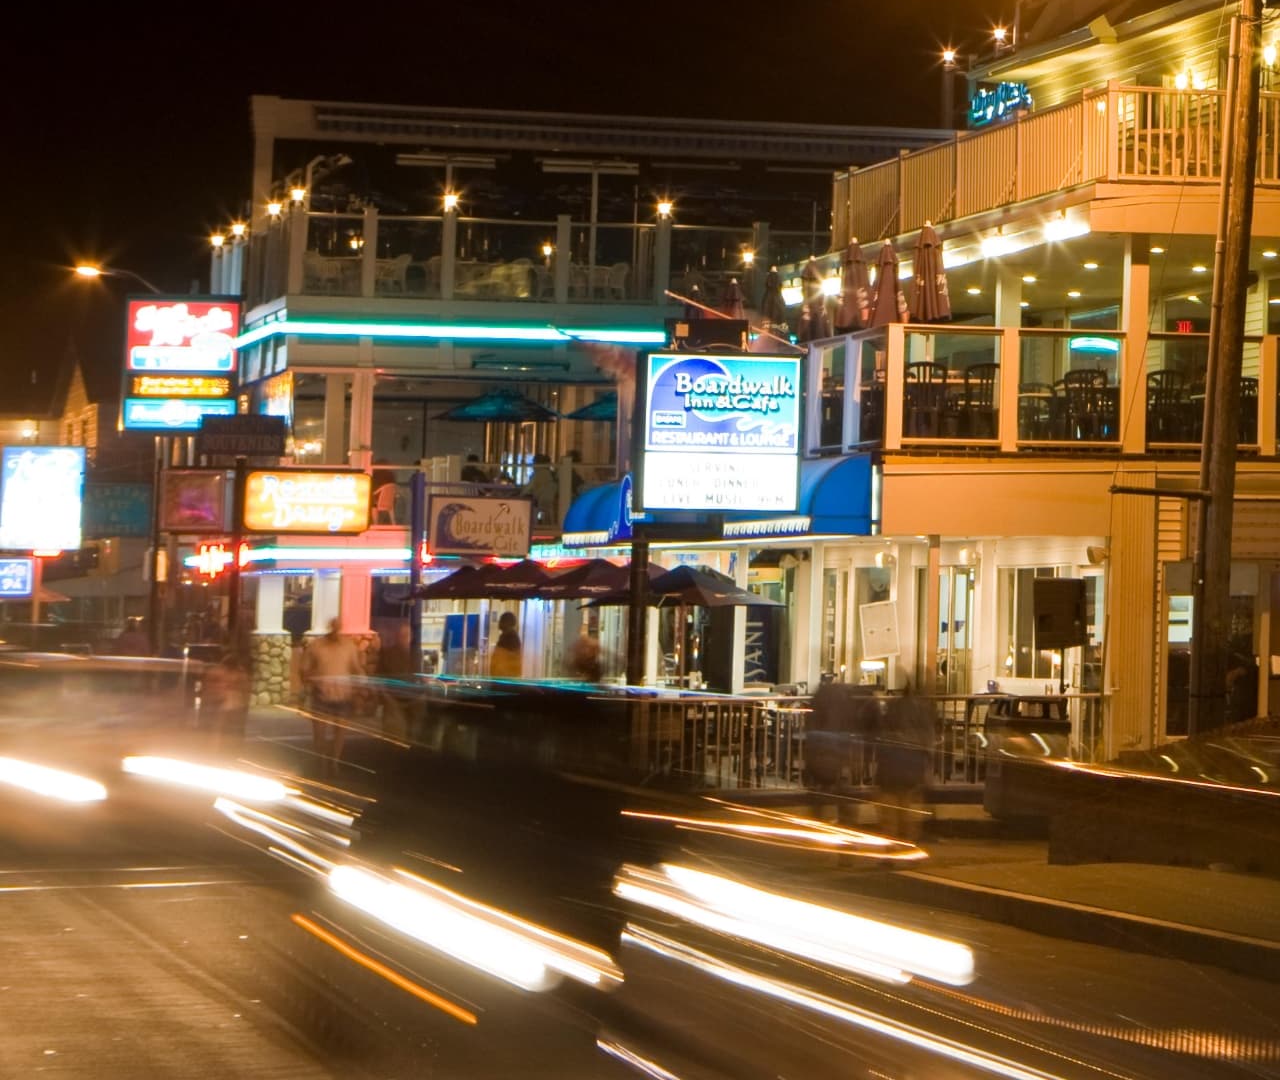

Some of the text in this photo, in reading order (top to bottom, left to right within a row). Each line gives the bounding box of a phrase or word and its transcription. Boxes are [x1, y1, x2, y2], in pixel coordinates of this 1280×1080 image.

[675, 372, 794, 396] Boardwalk
[685, 395, 714, 409] Inn
[651, 431, 729, 446] RESTAURANT
[455, 512, 525, 536] Boardwalk
